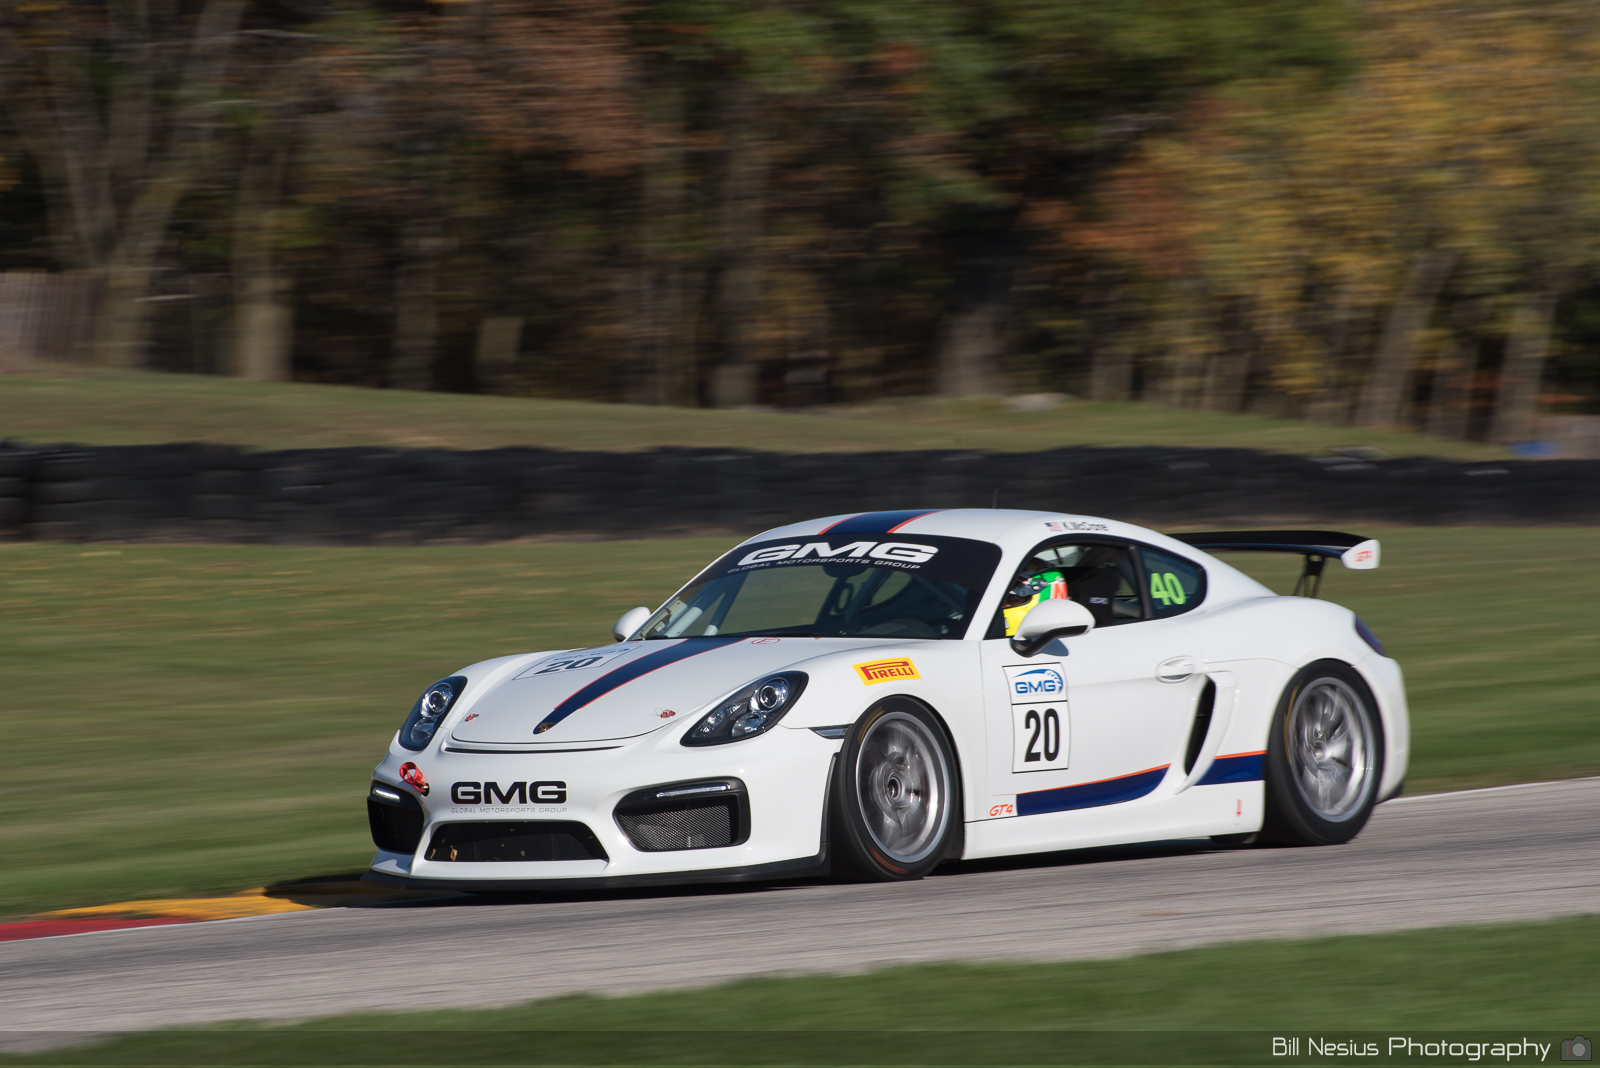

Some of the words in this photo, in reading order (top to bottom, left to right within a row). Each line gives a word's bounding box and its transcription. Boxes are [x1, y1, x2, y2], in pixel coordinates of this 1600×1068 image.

[737, 541, 940, 567] GMG
[726, 561, 772, 574] GLOBAL
[775, 557, 871, 567] MOTORSPORTS
[873, 559, 921, 570] GROUP
[1149, 572, 1187, 606] 40
[533, 656, 604, 676] 20
[860, 661, 915, 681] PIRELLI
[1015, 680, 1057, 695] GMG
[1024, 708, 1061, 763] 20
[450, 780, 568, 805] GMG
[989, 803, 1014, 817] GT4
